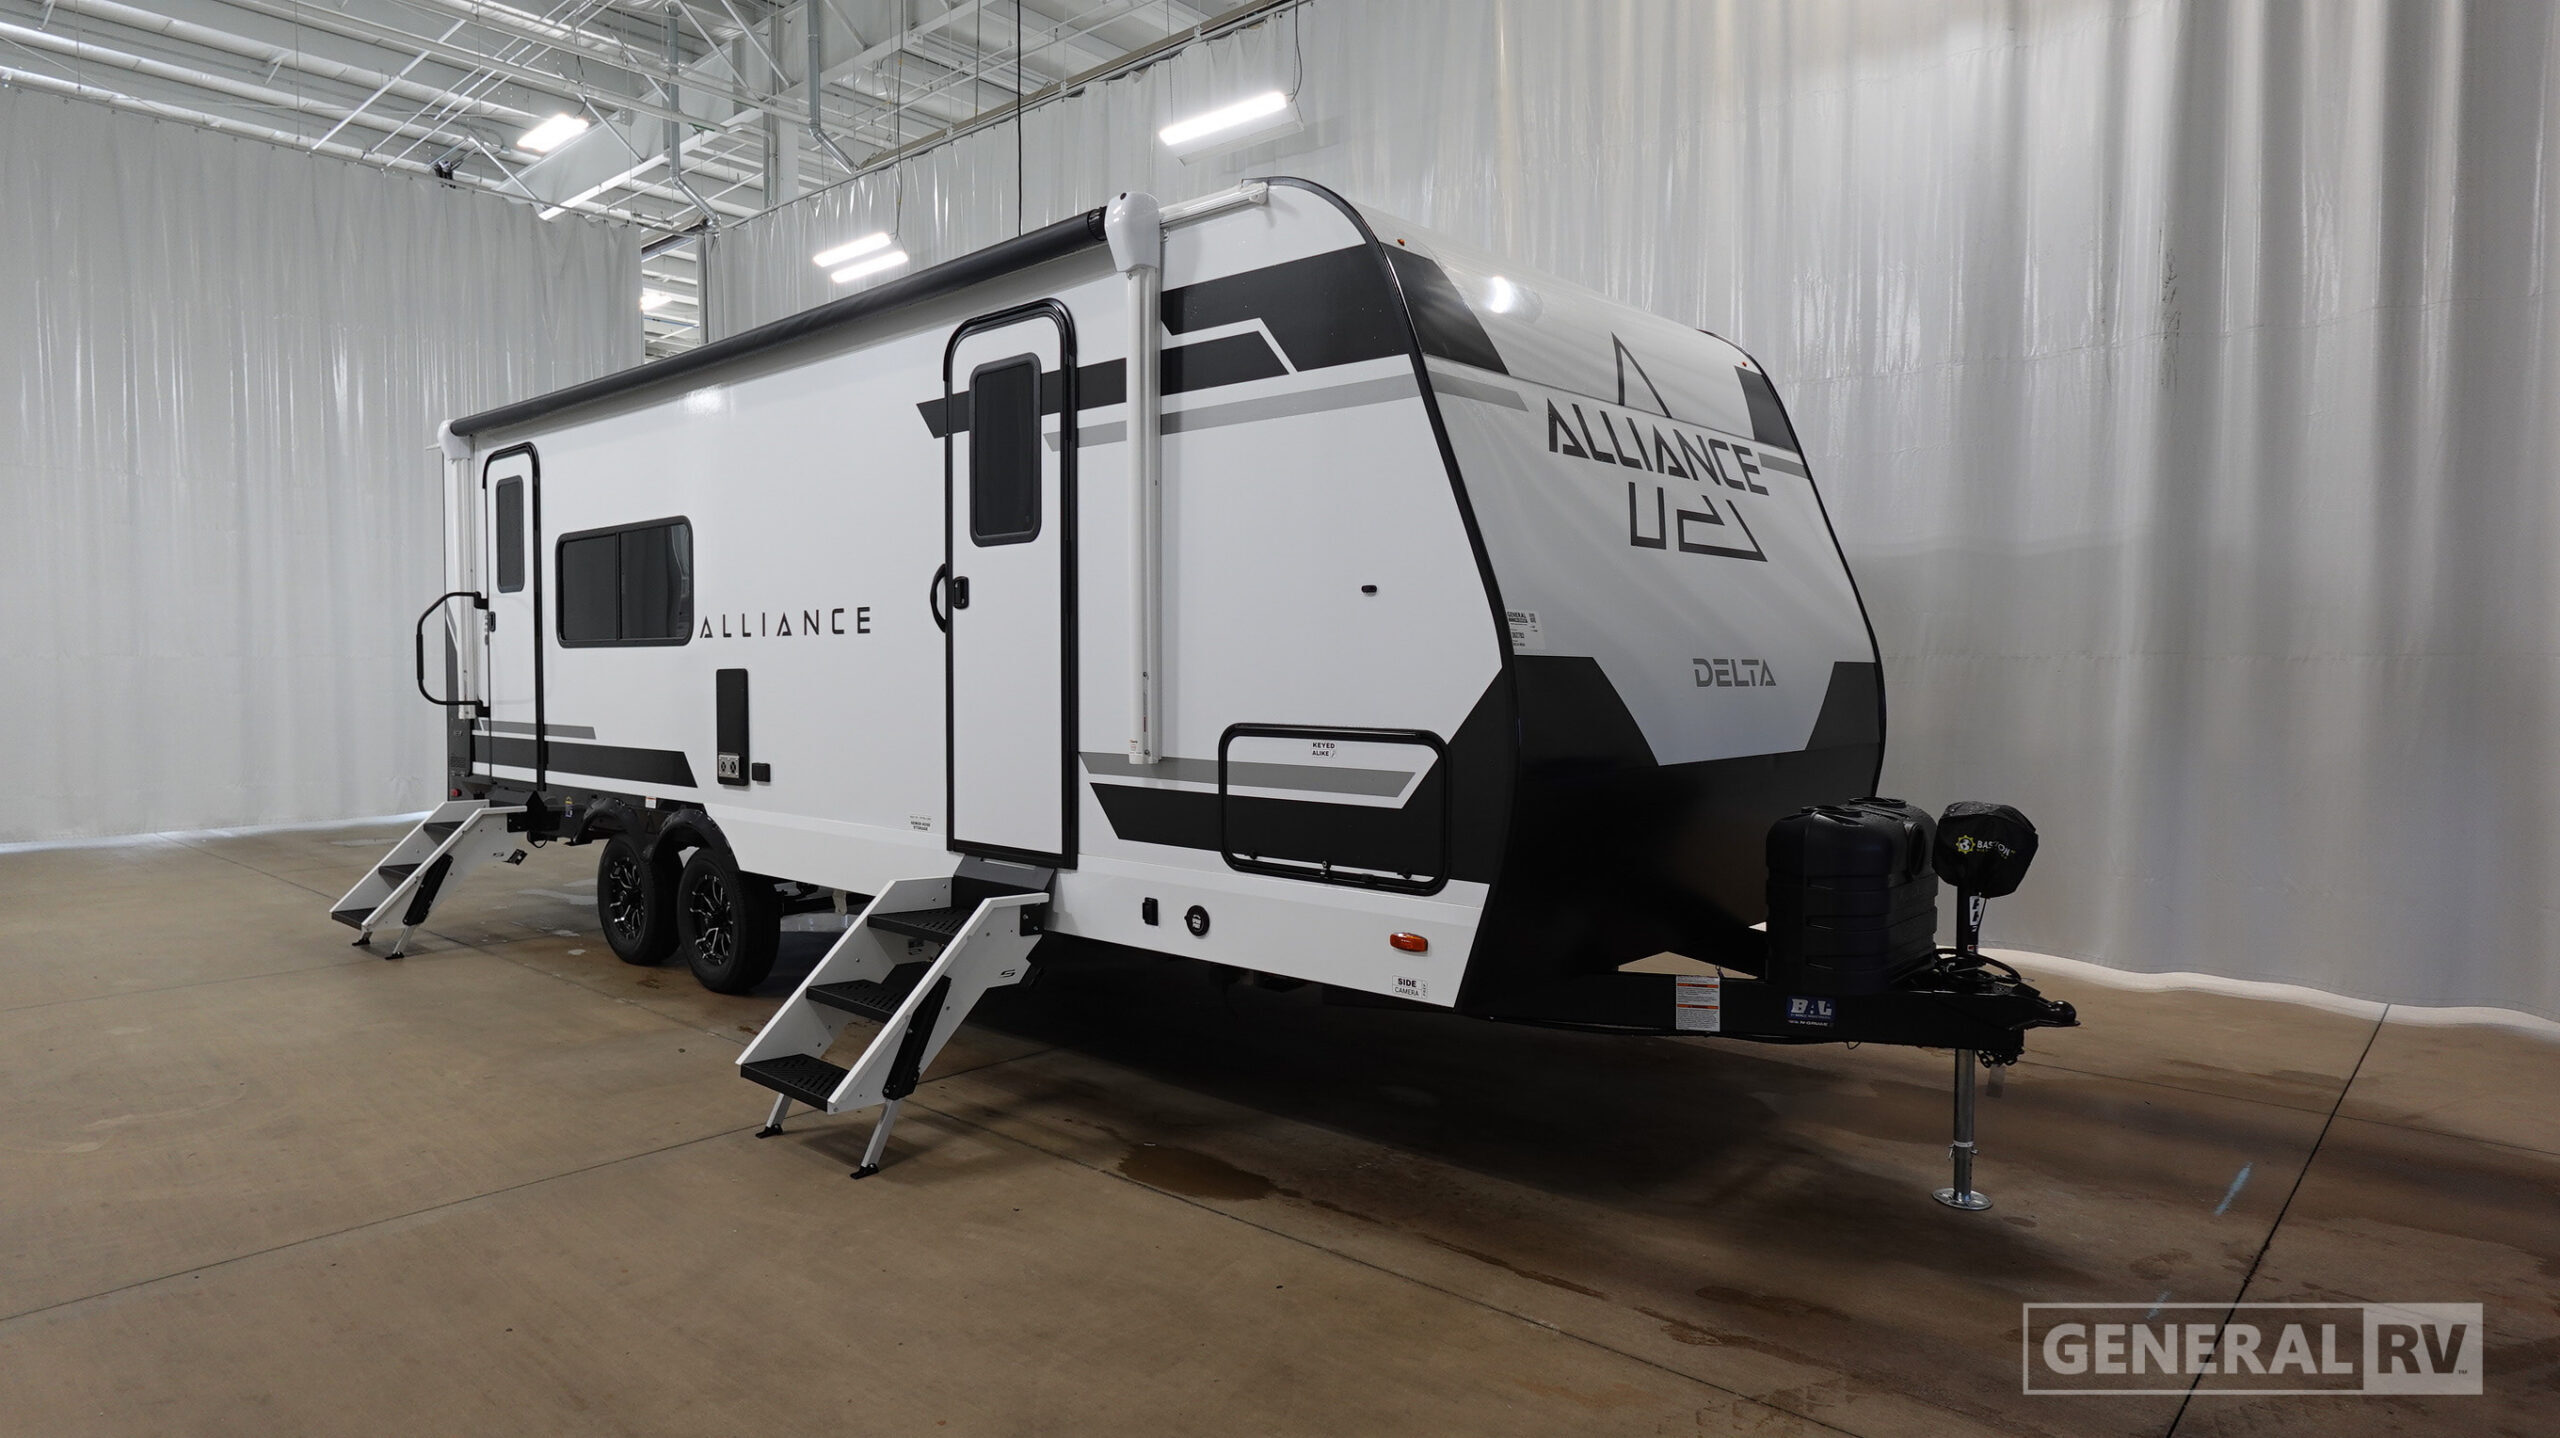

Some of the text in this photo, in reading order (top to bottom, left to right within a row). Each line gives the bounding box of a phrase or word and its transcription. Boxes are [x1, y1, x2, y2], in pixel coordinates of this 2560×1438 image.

[1547, 398, 1769, 496] ALLIANCE
[700, 606, 871, 639] ALLIANCE
[1692, 658, 1777, 688] DELTA
[1394, 986, 1419, 997] CAMERA
[1397, 978, 1417, 988] SIDE
